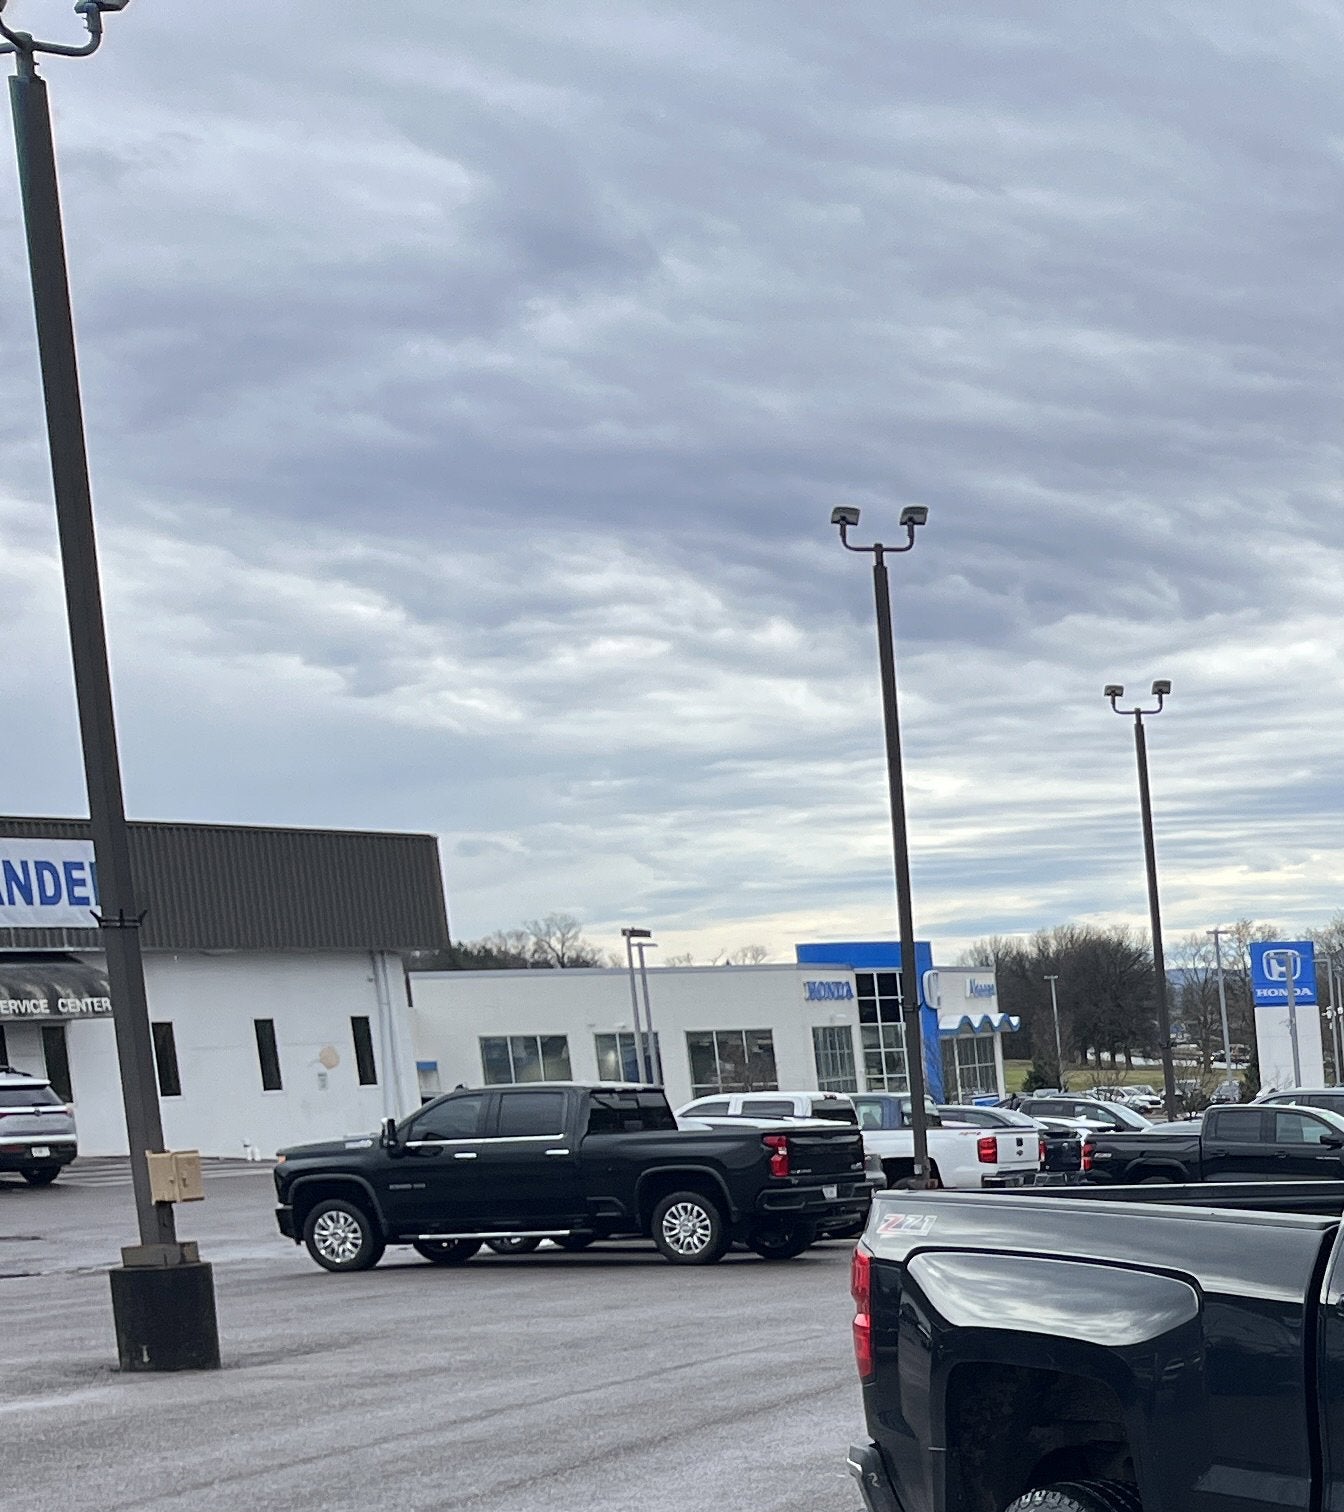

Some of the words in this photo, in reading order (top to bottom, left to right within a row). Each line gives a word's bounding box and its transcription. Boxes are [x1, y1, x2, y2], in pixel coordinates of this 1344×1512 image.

[0, 860, 101, 906] NDE
[0, 998, 50, 1014] ERVICE
[58, 996, 112, 1013] CENTER
[876, 1213, 938, 1237] Z71
